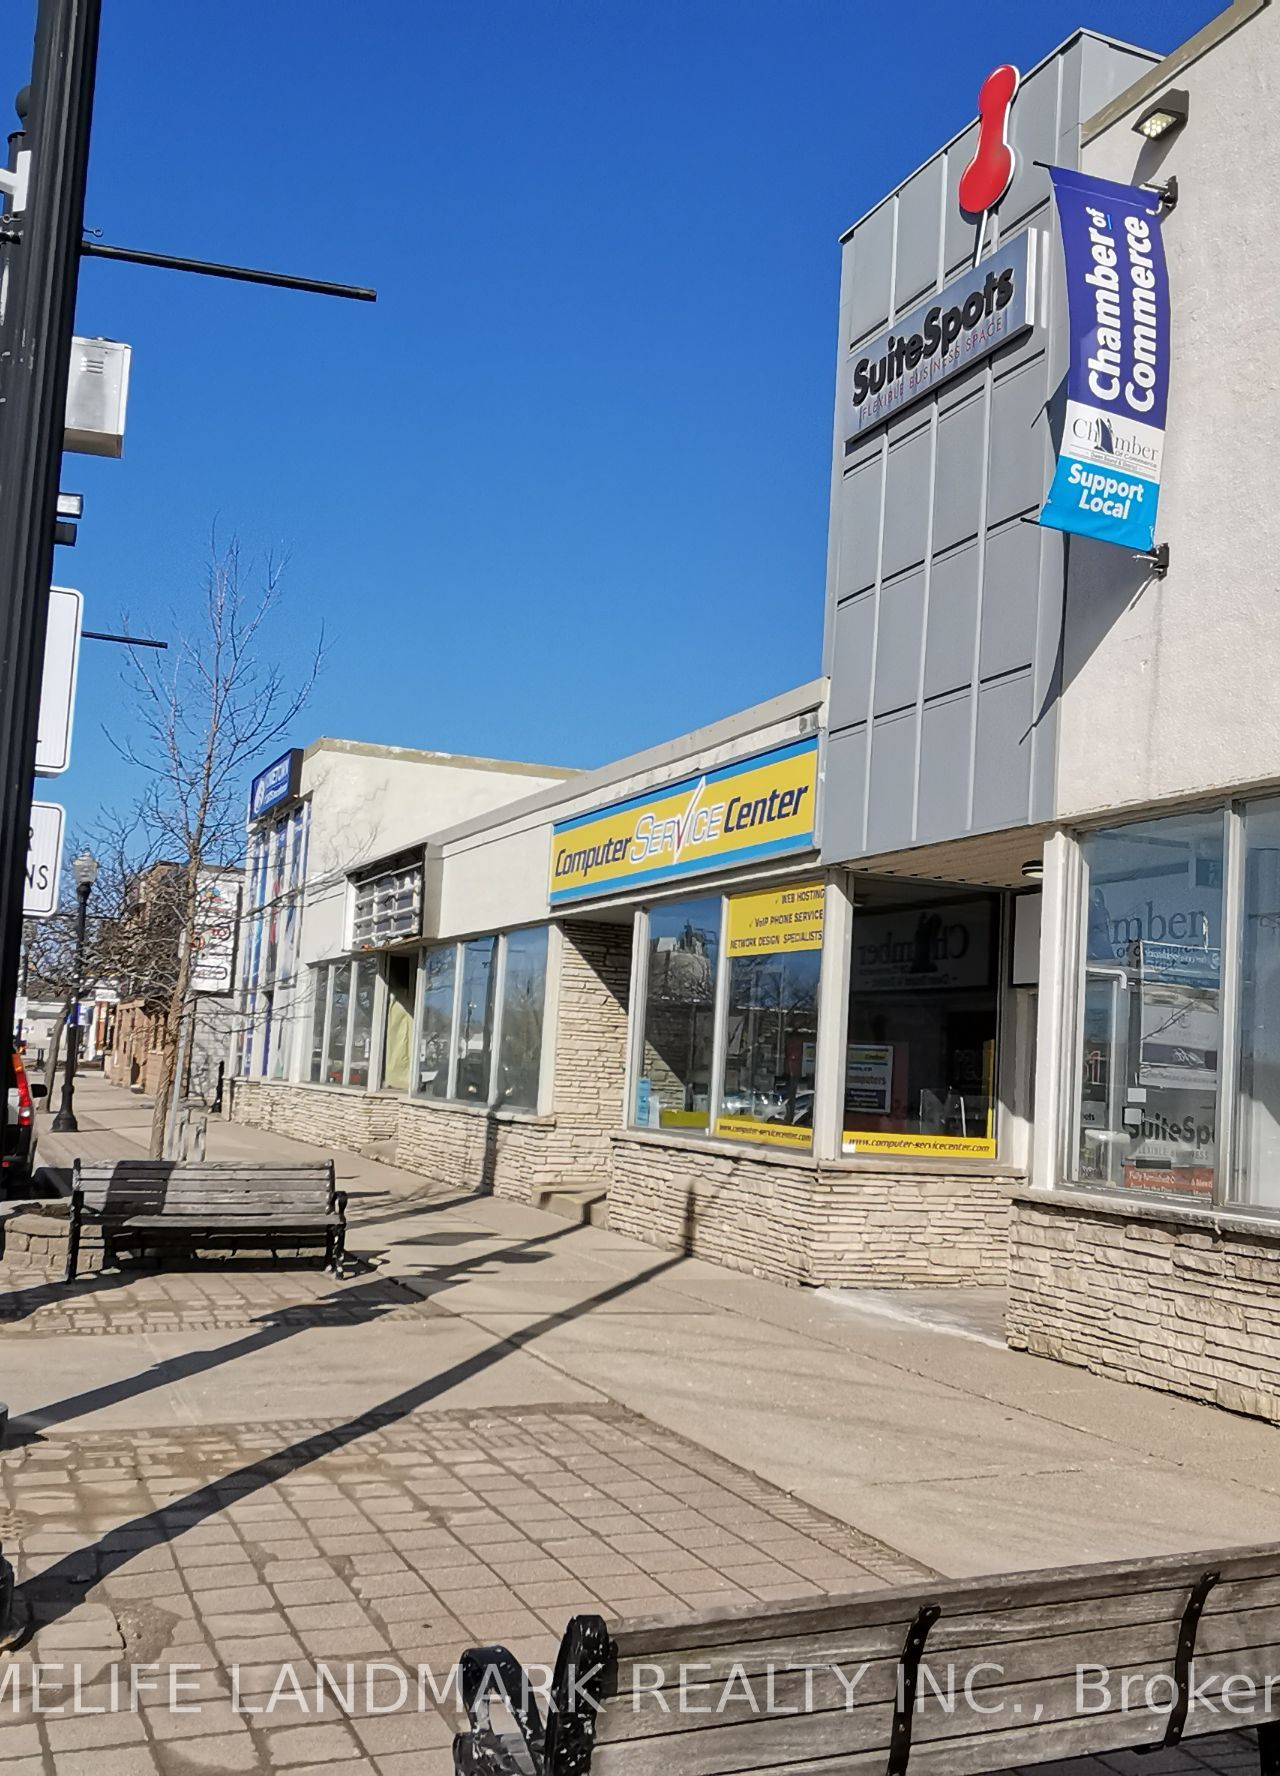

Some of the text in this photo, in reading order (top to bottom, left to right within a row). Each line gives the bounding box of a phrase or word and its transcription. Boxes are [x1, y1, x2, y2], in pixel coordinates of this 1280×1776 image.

[1085, 206, 1122, 401] Chamber of
[1124, 216, 1157, 412] Commerce
[853, 268, 1014, 407] SuiteSpots
[909, 345, 961, 389] BUSINESS
[966, 317, 1003, 352] SPACE
[1067, 463, 1145, 502] Support
[1079, 489, 1131, 519] Local
[554, 835, 632, 878] Computer
[723, 785, 810, 833] Center
[781, 888, 825, 904] WEB HOSTING
[770, 913, 793, 926] PHONE
[794, 909, 823, 923] SERVICE
[730, 930, 823, 949] NETWORK DESIGN SPECIALISTS
[848, 1136, 990, 1153] www.computer-servicecenter.com
